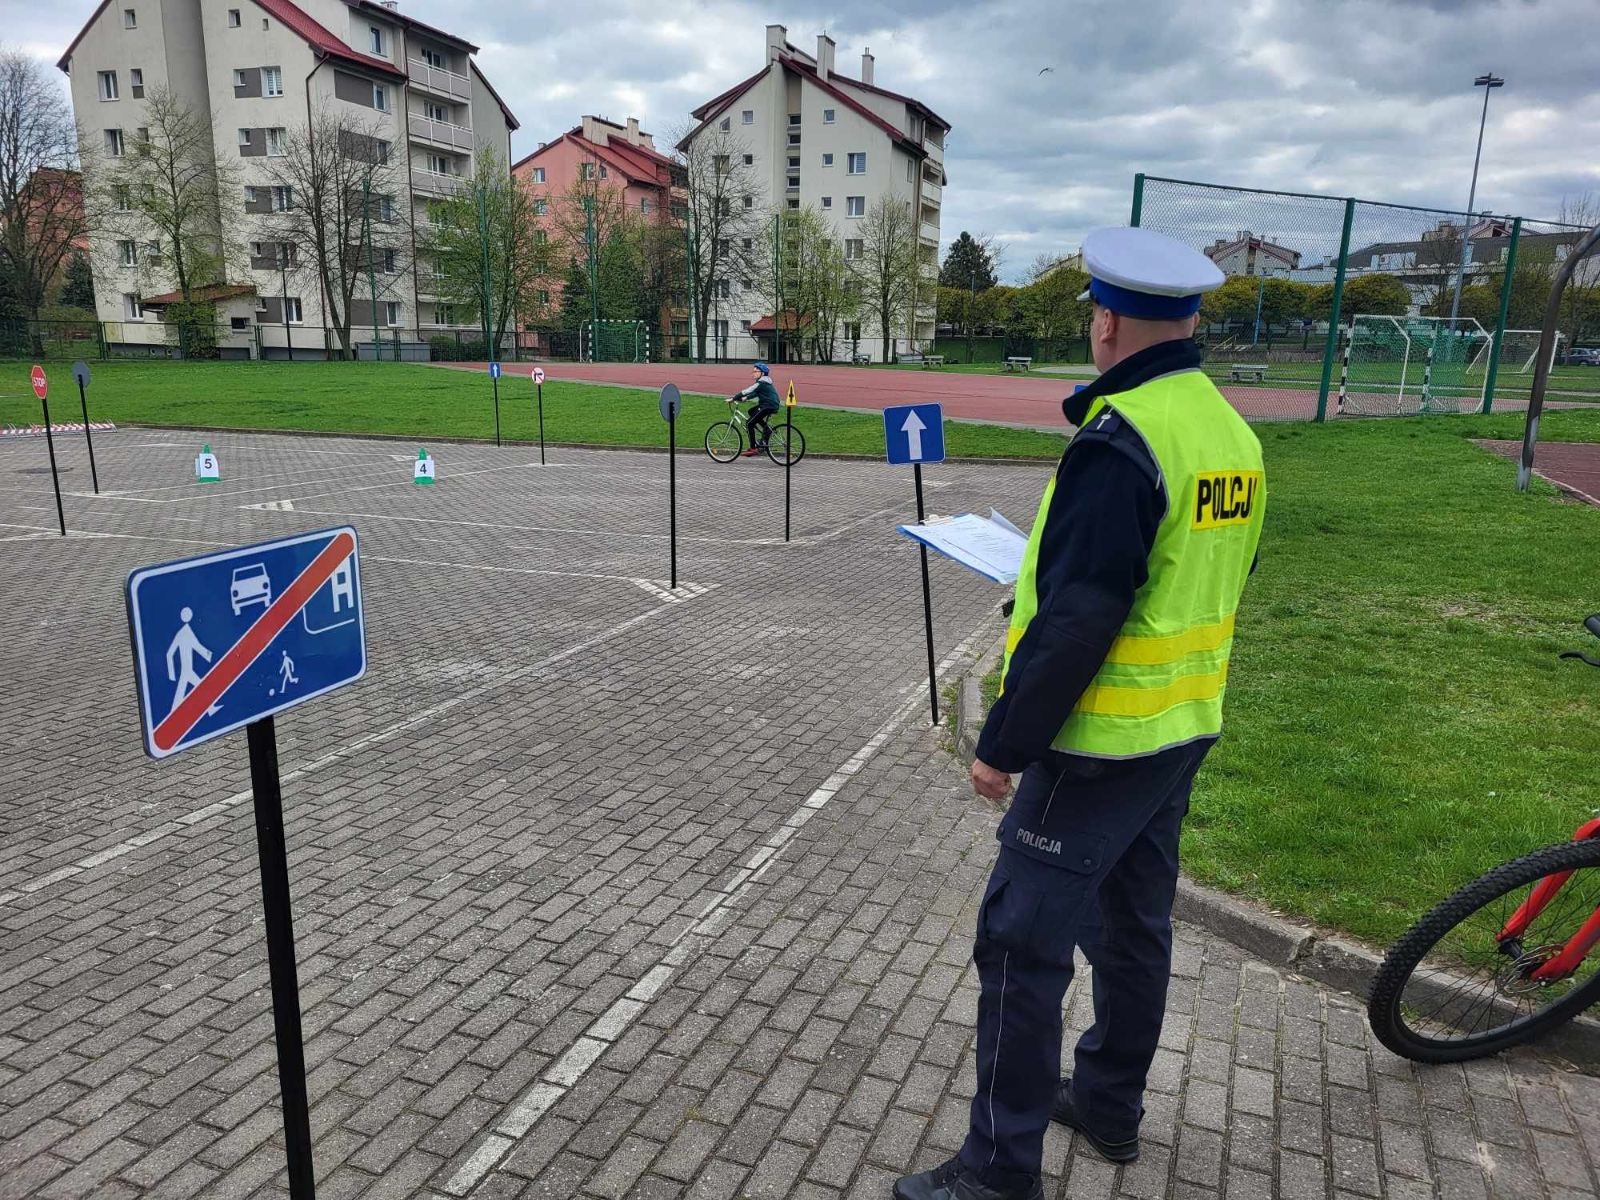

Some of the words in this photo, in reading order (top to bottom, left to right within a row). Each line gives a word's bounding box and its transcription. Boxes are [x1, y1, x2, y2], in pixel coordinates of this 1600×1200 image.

[33, 377, 46, 388] STOP
[204, 458, 213, 470] 5
[419, 463, 428, 474] 4
[1196, 476, 1257, 523] POLCJ
[1016, 827, 1062, 855] POLICJA
